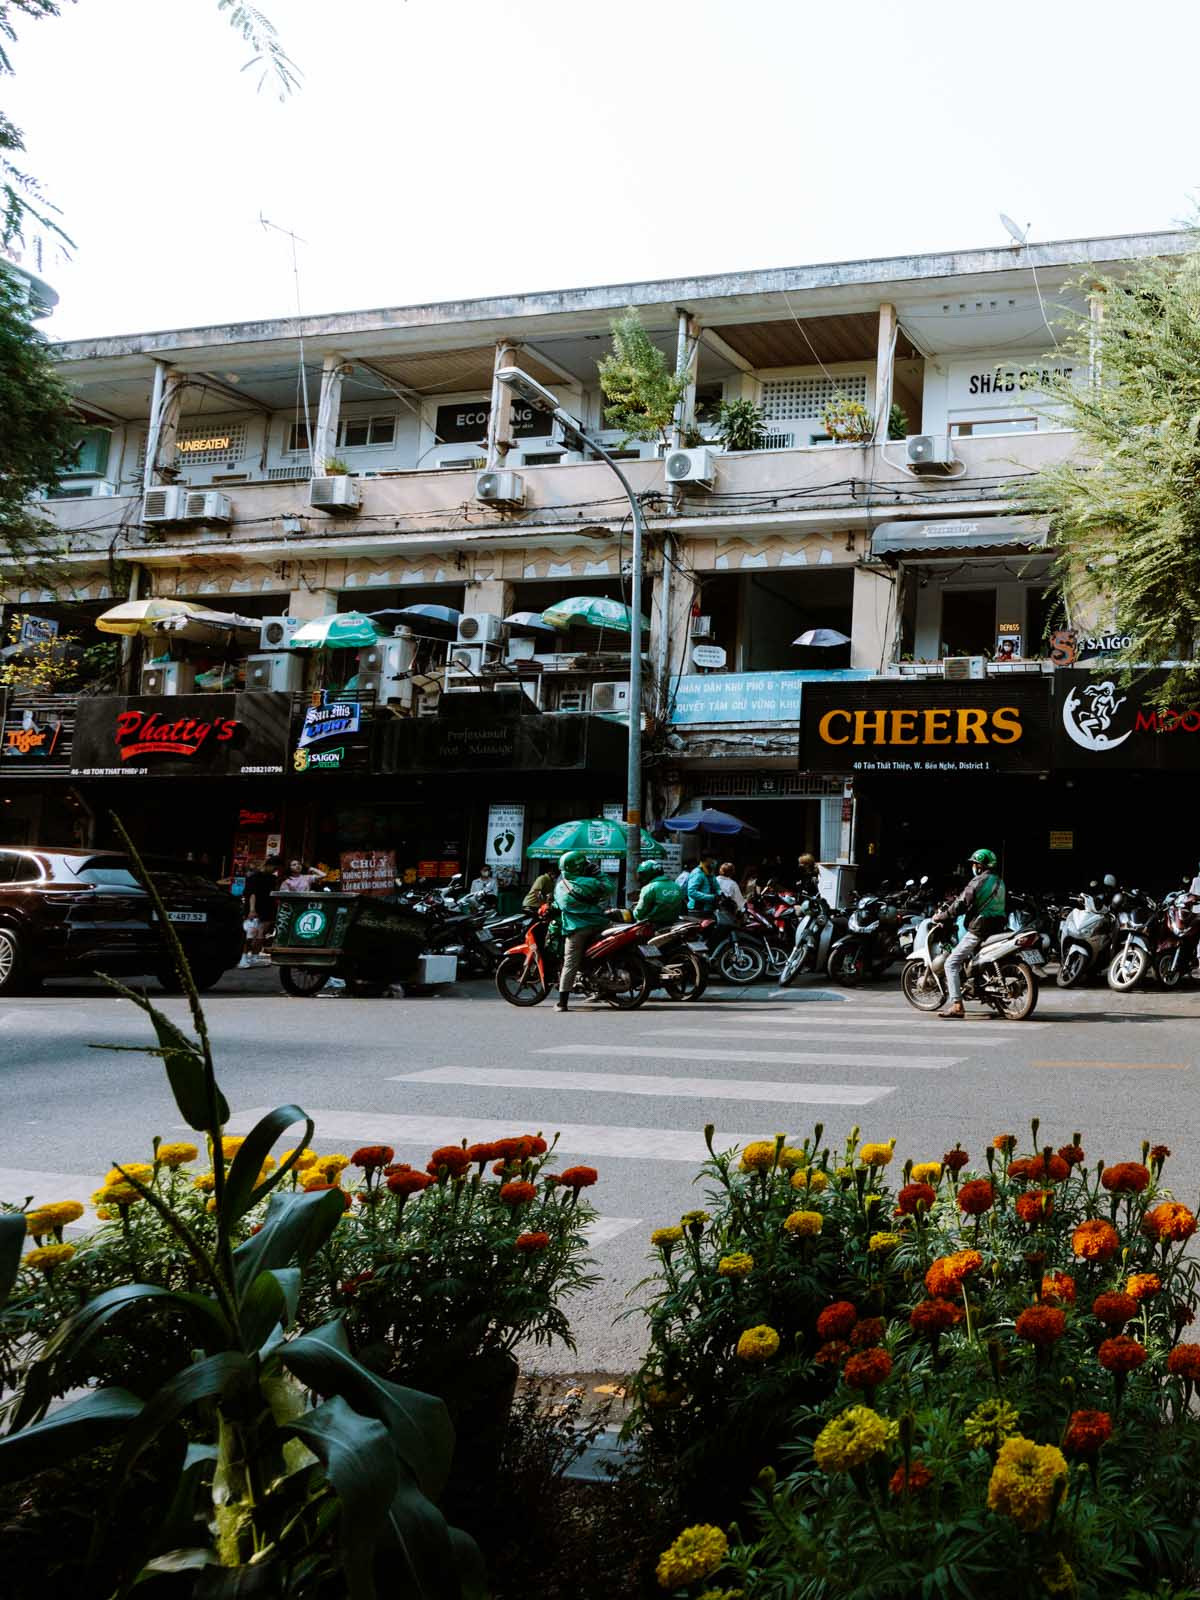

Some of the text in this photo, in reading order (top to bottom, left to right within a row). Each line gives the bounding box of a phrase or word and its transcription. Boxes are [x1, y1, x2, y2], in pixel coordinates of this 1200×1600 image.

[180, 437, 230, 452] UNBEATEN
[1087, 635, 1138, 650] SAIGO
[114, 710, 239, 750] Phatty's
[818, 706, 1023, 746] CHEERS
[7, 729, 47, 753] Tiger
[311, 753, 340, 762] SAIGON
[852, 761, 862, 769] 40
[959, 761, 983, 769] District
